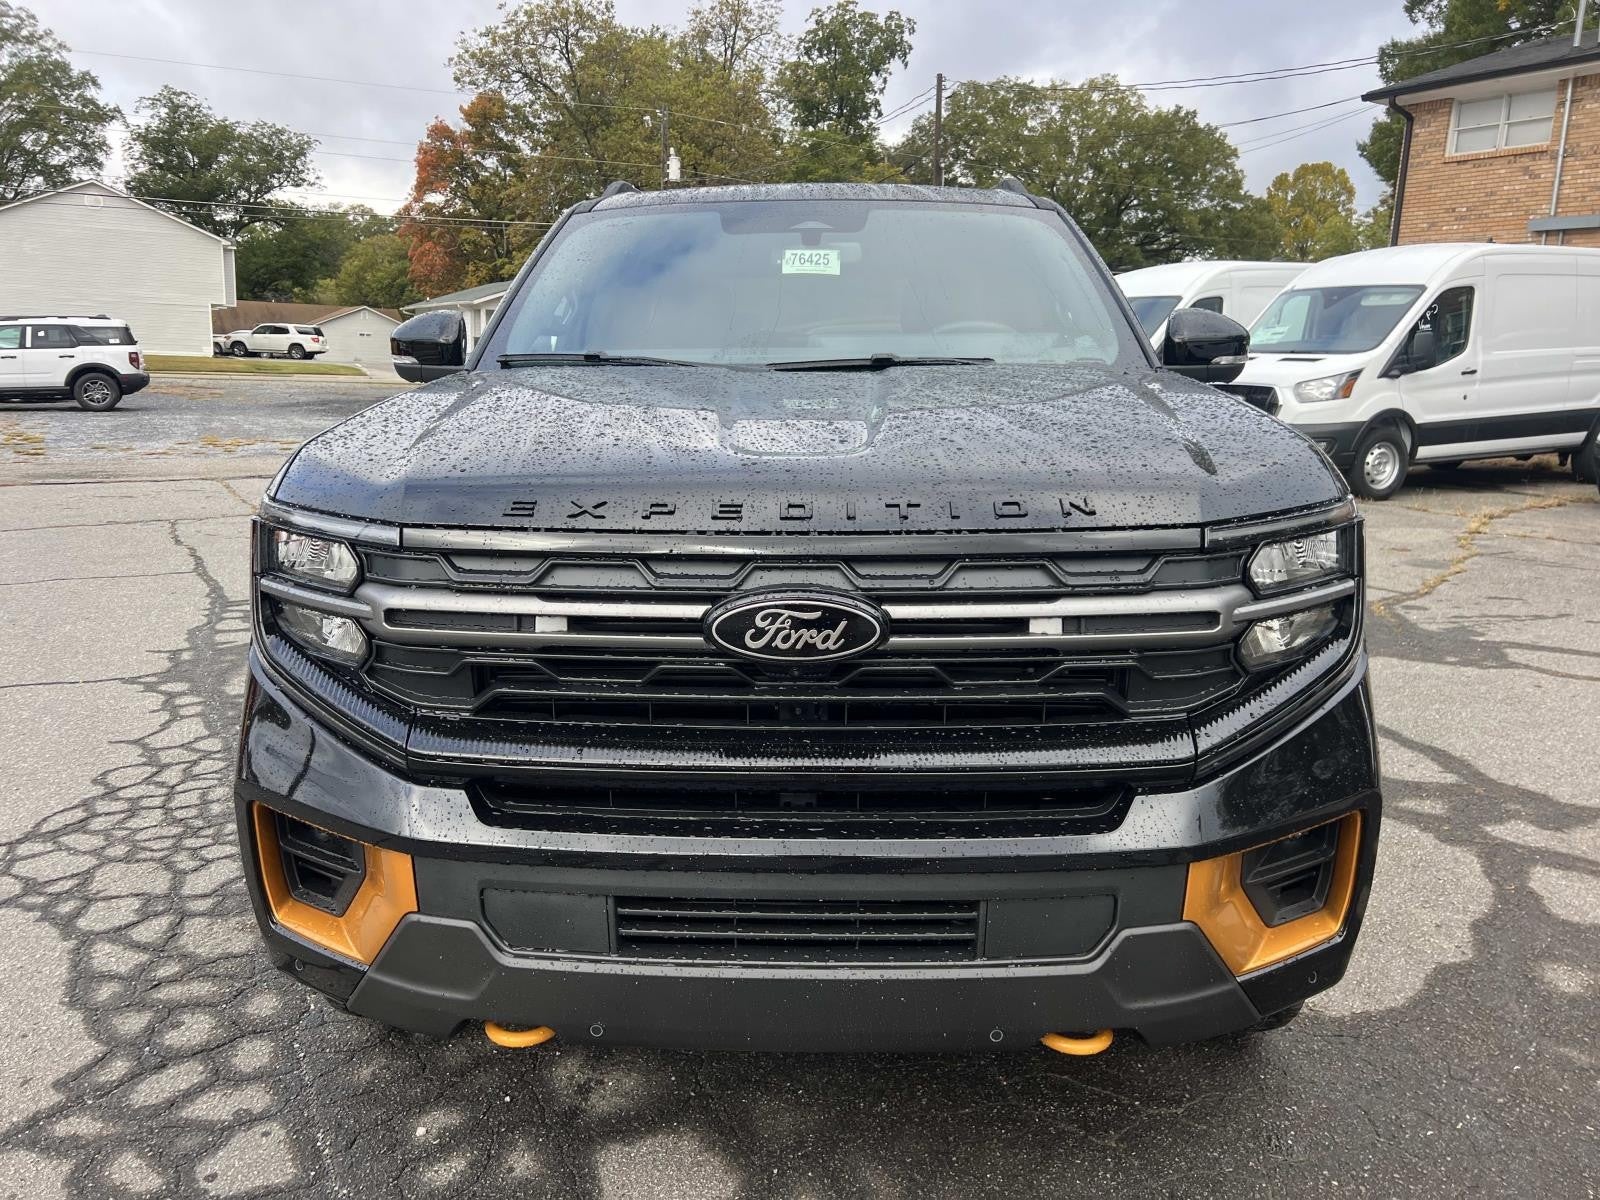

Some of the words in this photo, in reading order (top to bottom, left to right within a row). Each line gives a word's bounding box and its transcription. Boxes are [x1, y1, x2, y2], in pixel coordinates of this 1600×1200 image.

[791, 252, 830, 266] 76425
[502, 498, 1096, 520] EXPEDITION
[744, 608, 848, 650] Ford
